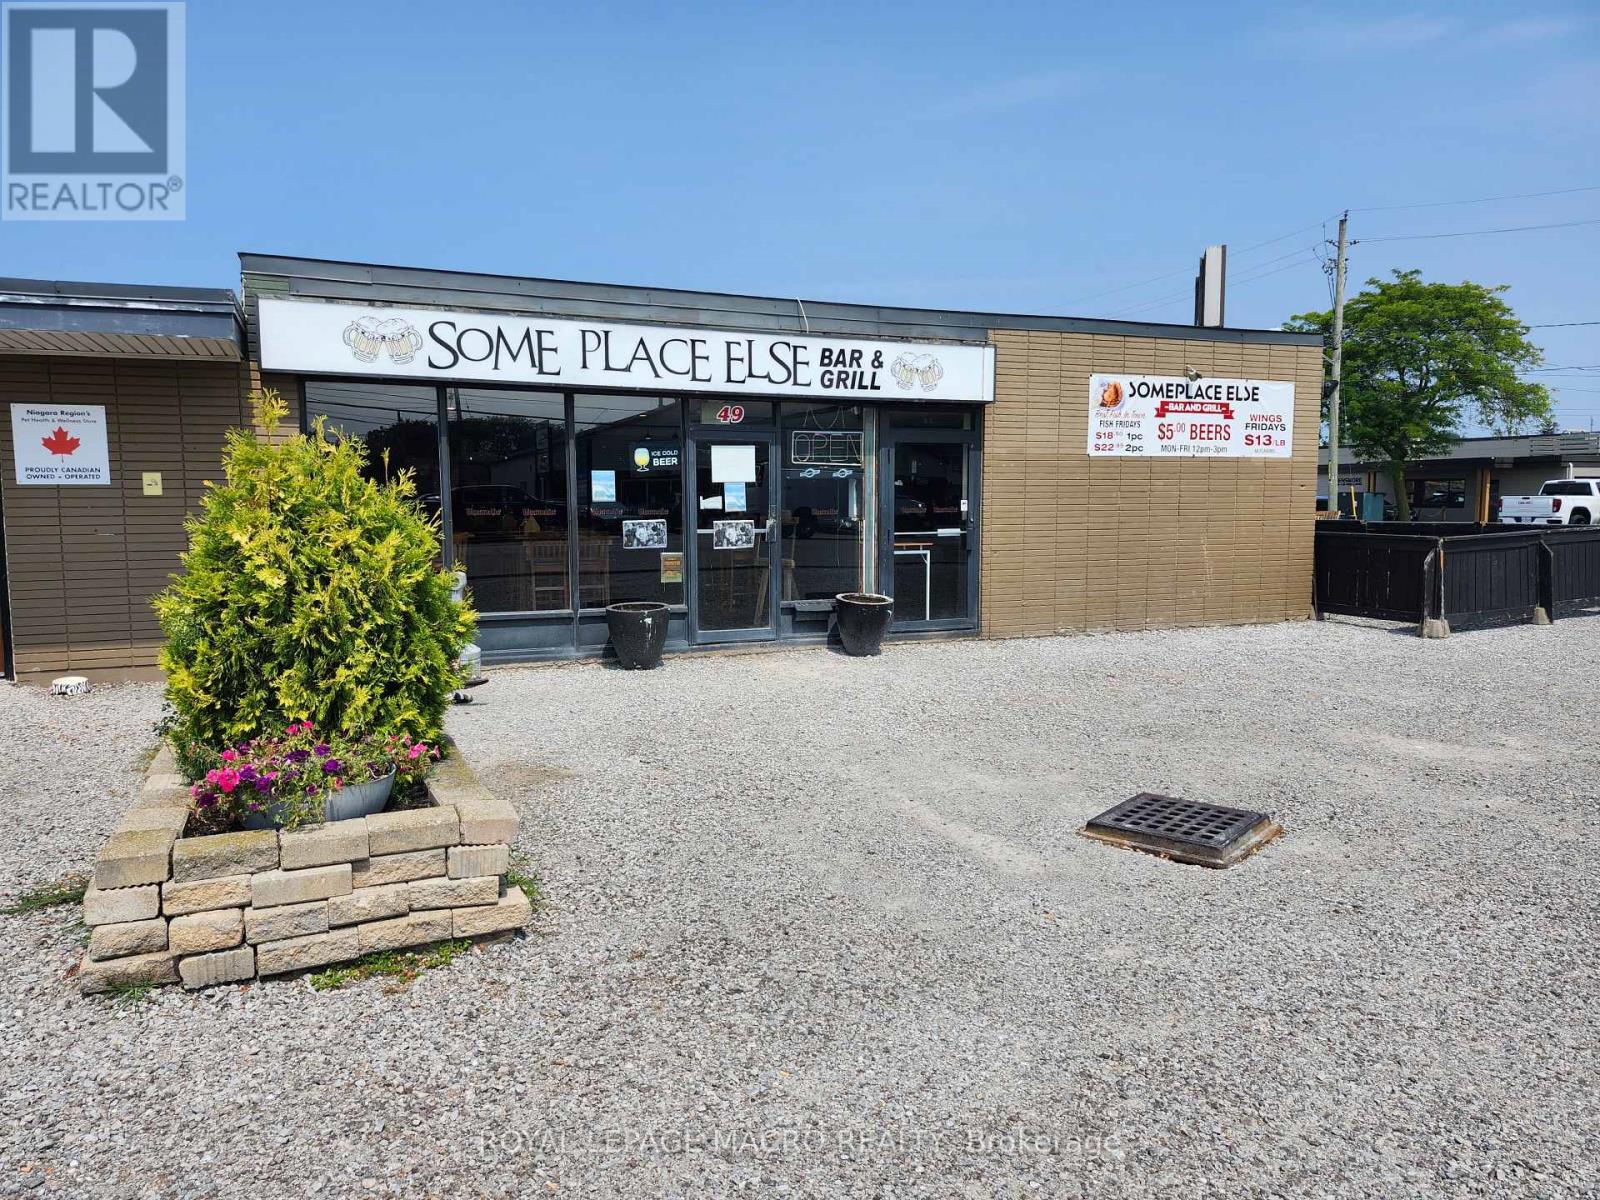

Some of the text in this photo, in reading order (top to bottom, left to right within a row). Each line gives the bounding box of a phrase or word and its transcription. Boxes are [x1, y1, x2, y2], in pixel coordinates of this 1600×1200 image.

[580, 329, 711, 383] PLACE
[724, 339, 811, 386] ELSE
[820, 348, 862, 368] BAR
[873, 350, 884, 369] &
[820, 370, 881, 390] GRILL
[1128, 381, 1260, 402] SOMEPLACE ELSE
[1184, 404, 1201, 412] AND
[26, 409, 91, 418] Niagara Region's
[717, 405, 744, 423] 49
[1250, 414, 1283, 423] WINGS
[1099, 420, 1141, 428] FISH FRIDAYS
[1245, 422, 1286, 431] FRIDAYS
[1127, 432, 1143, 441] 1pc
[1189, 423, 1231, 441] BEERS
[795, 434, 861, 462] OPEN
[1125, 443, 1144, 453] 2pc
[1160, 444, 1191, 453] MON-FRI
[653, 457, 678, 466] BEER
